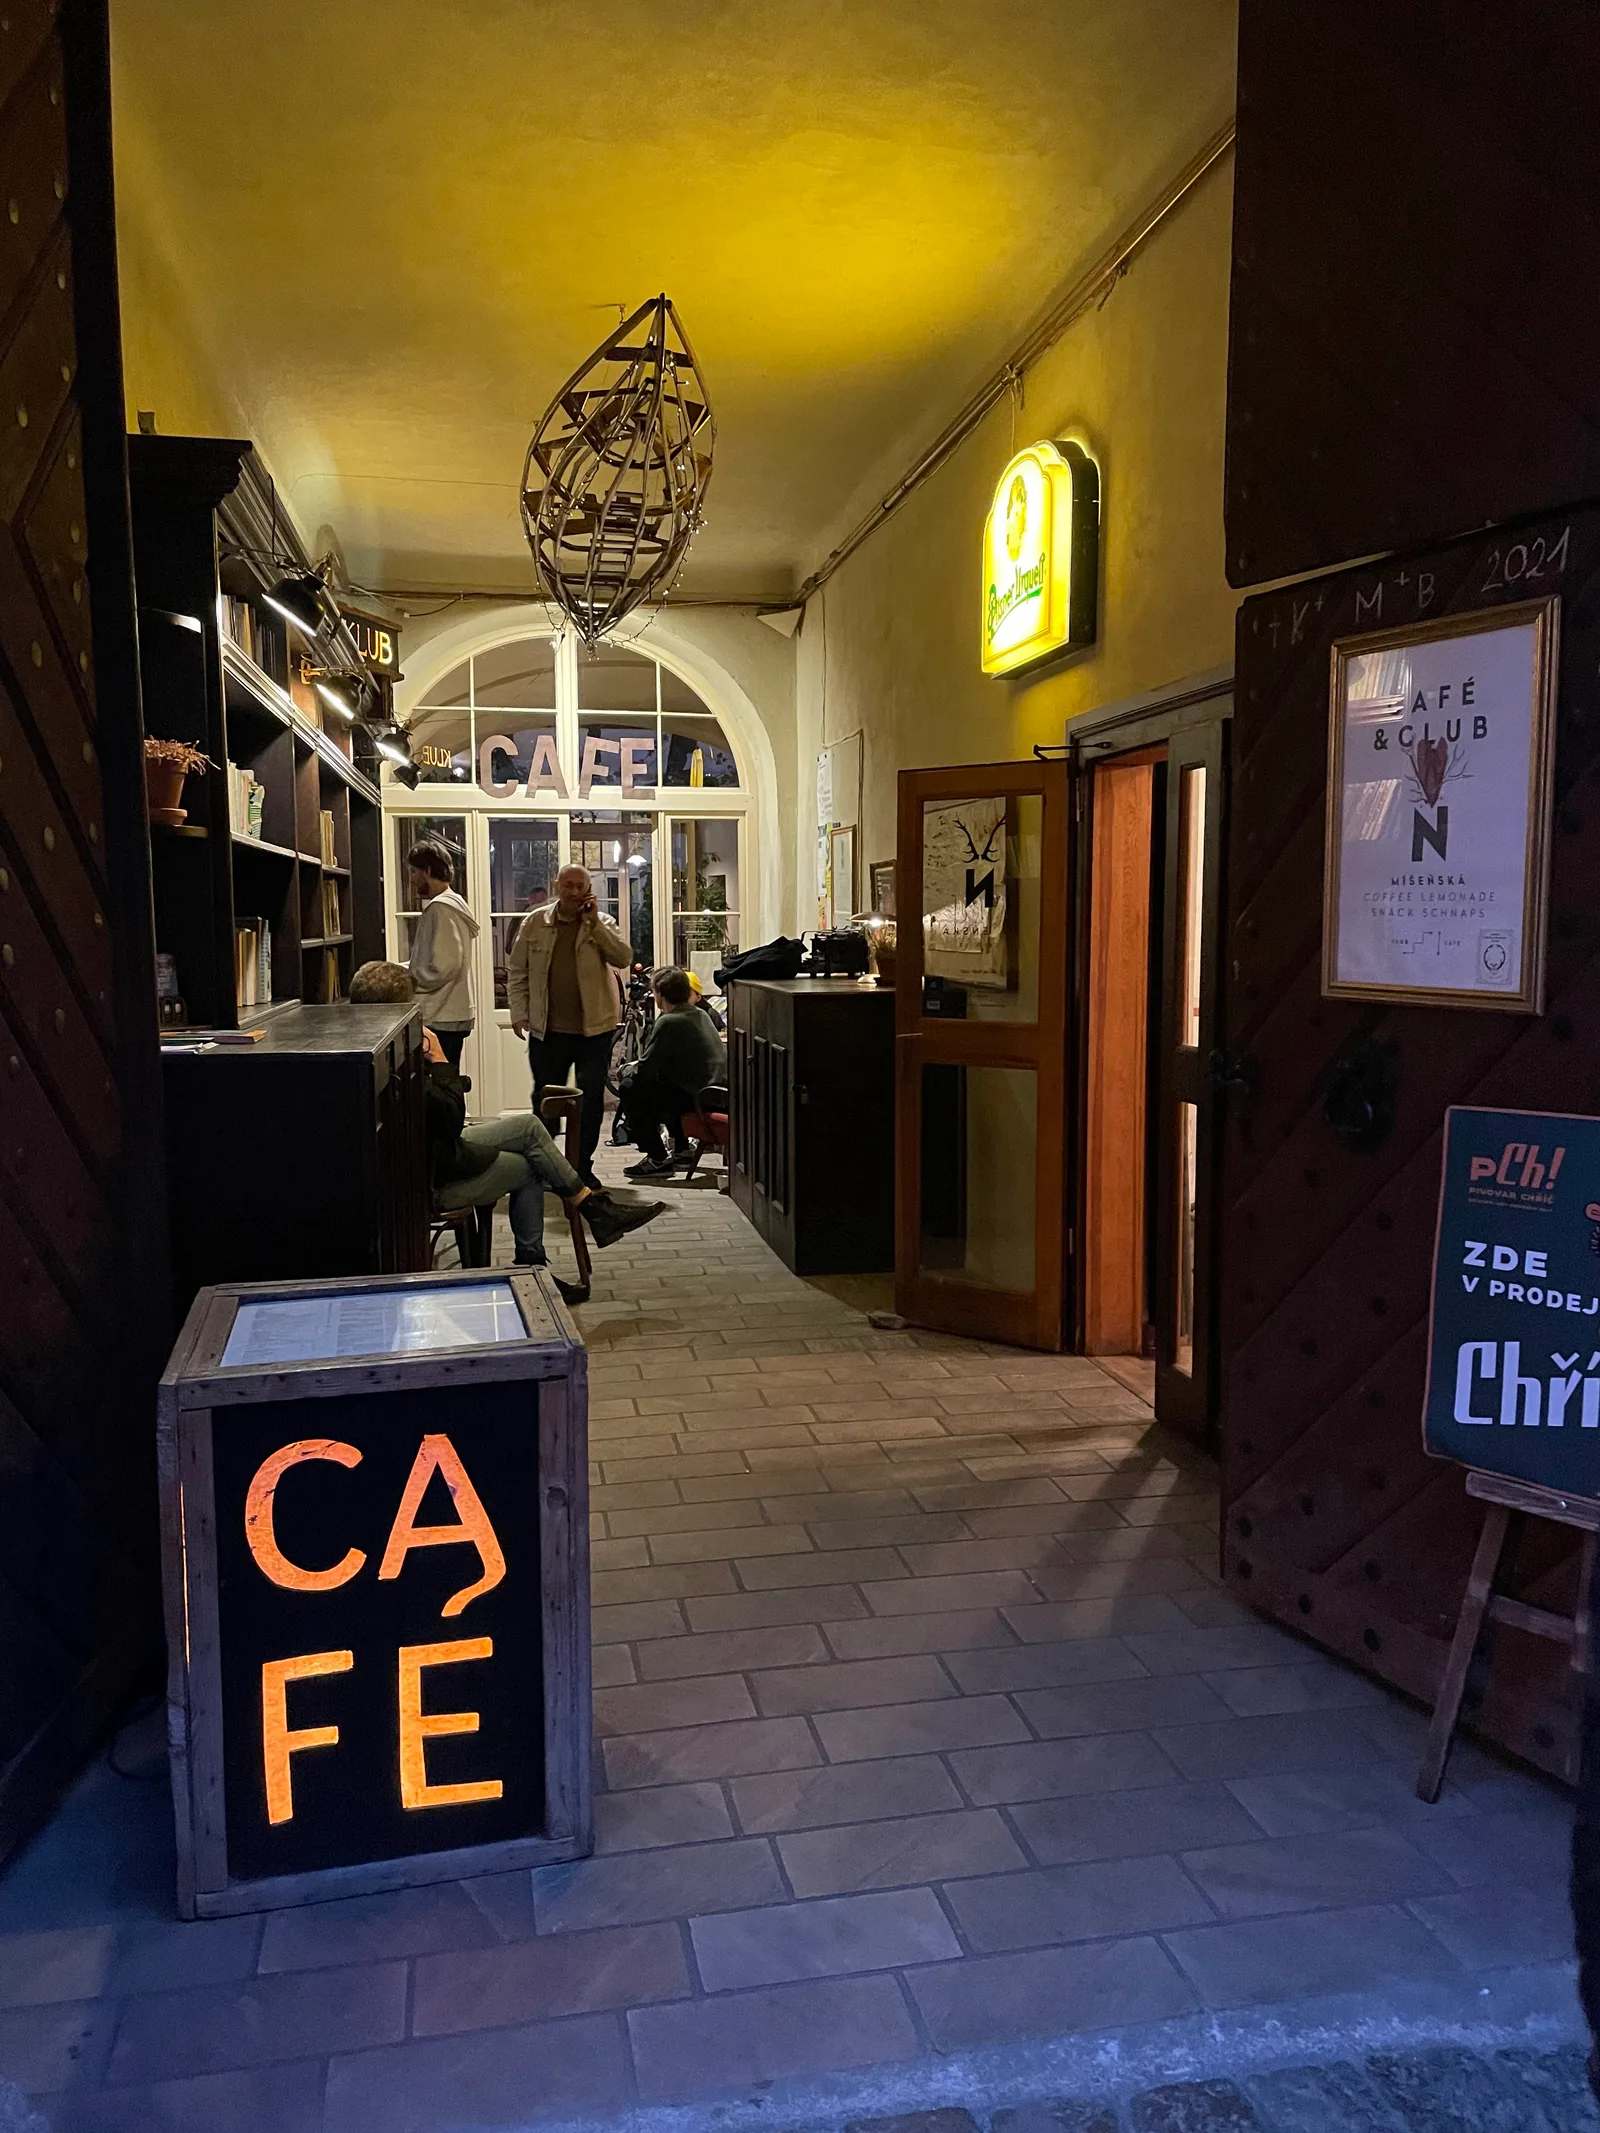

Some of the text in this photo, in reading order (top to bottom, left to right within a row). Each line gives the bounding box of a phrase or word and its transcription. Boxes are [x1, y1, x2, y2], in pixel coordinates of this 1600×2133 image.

[1480, 525, 1571, 592] 2021
[1388, 676, 1475, 716] AFÉ
[1399, 715, 1488, 749] CLUB
[479, 734, 656, 801] CAFE
[1411, 805, 1449, 863] N
[1363, 892, 1496, 902] COFFEE LEMONADE
[1371, 907, 1486, 918] SNACK SCHNAPS
[1468, 1186, 1517, 1200] PIVOVAR
[1462, 1240, 1549, 1278] ZDE
[1461, 1274, 1480, 1293] V
